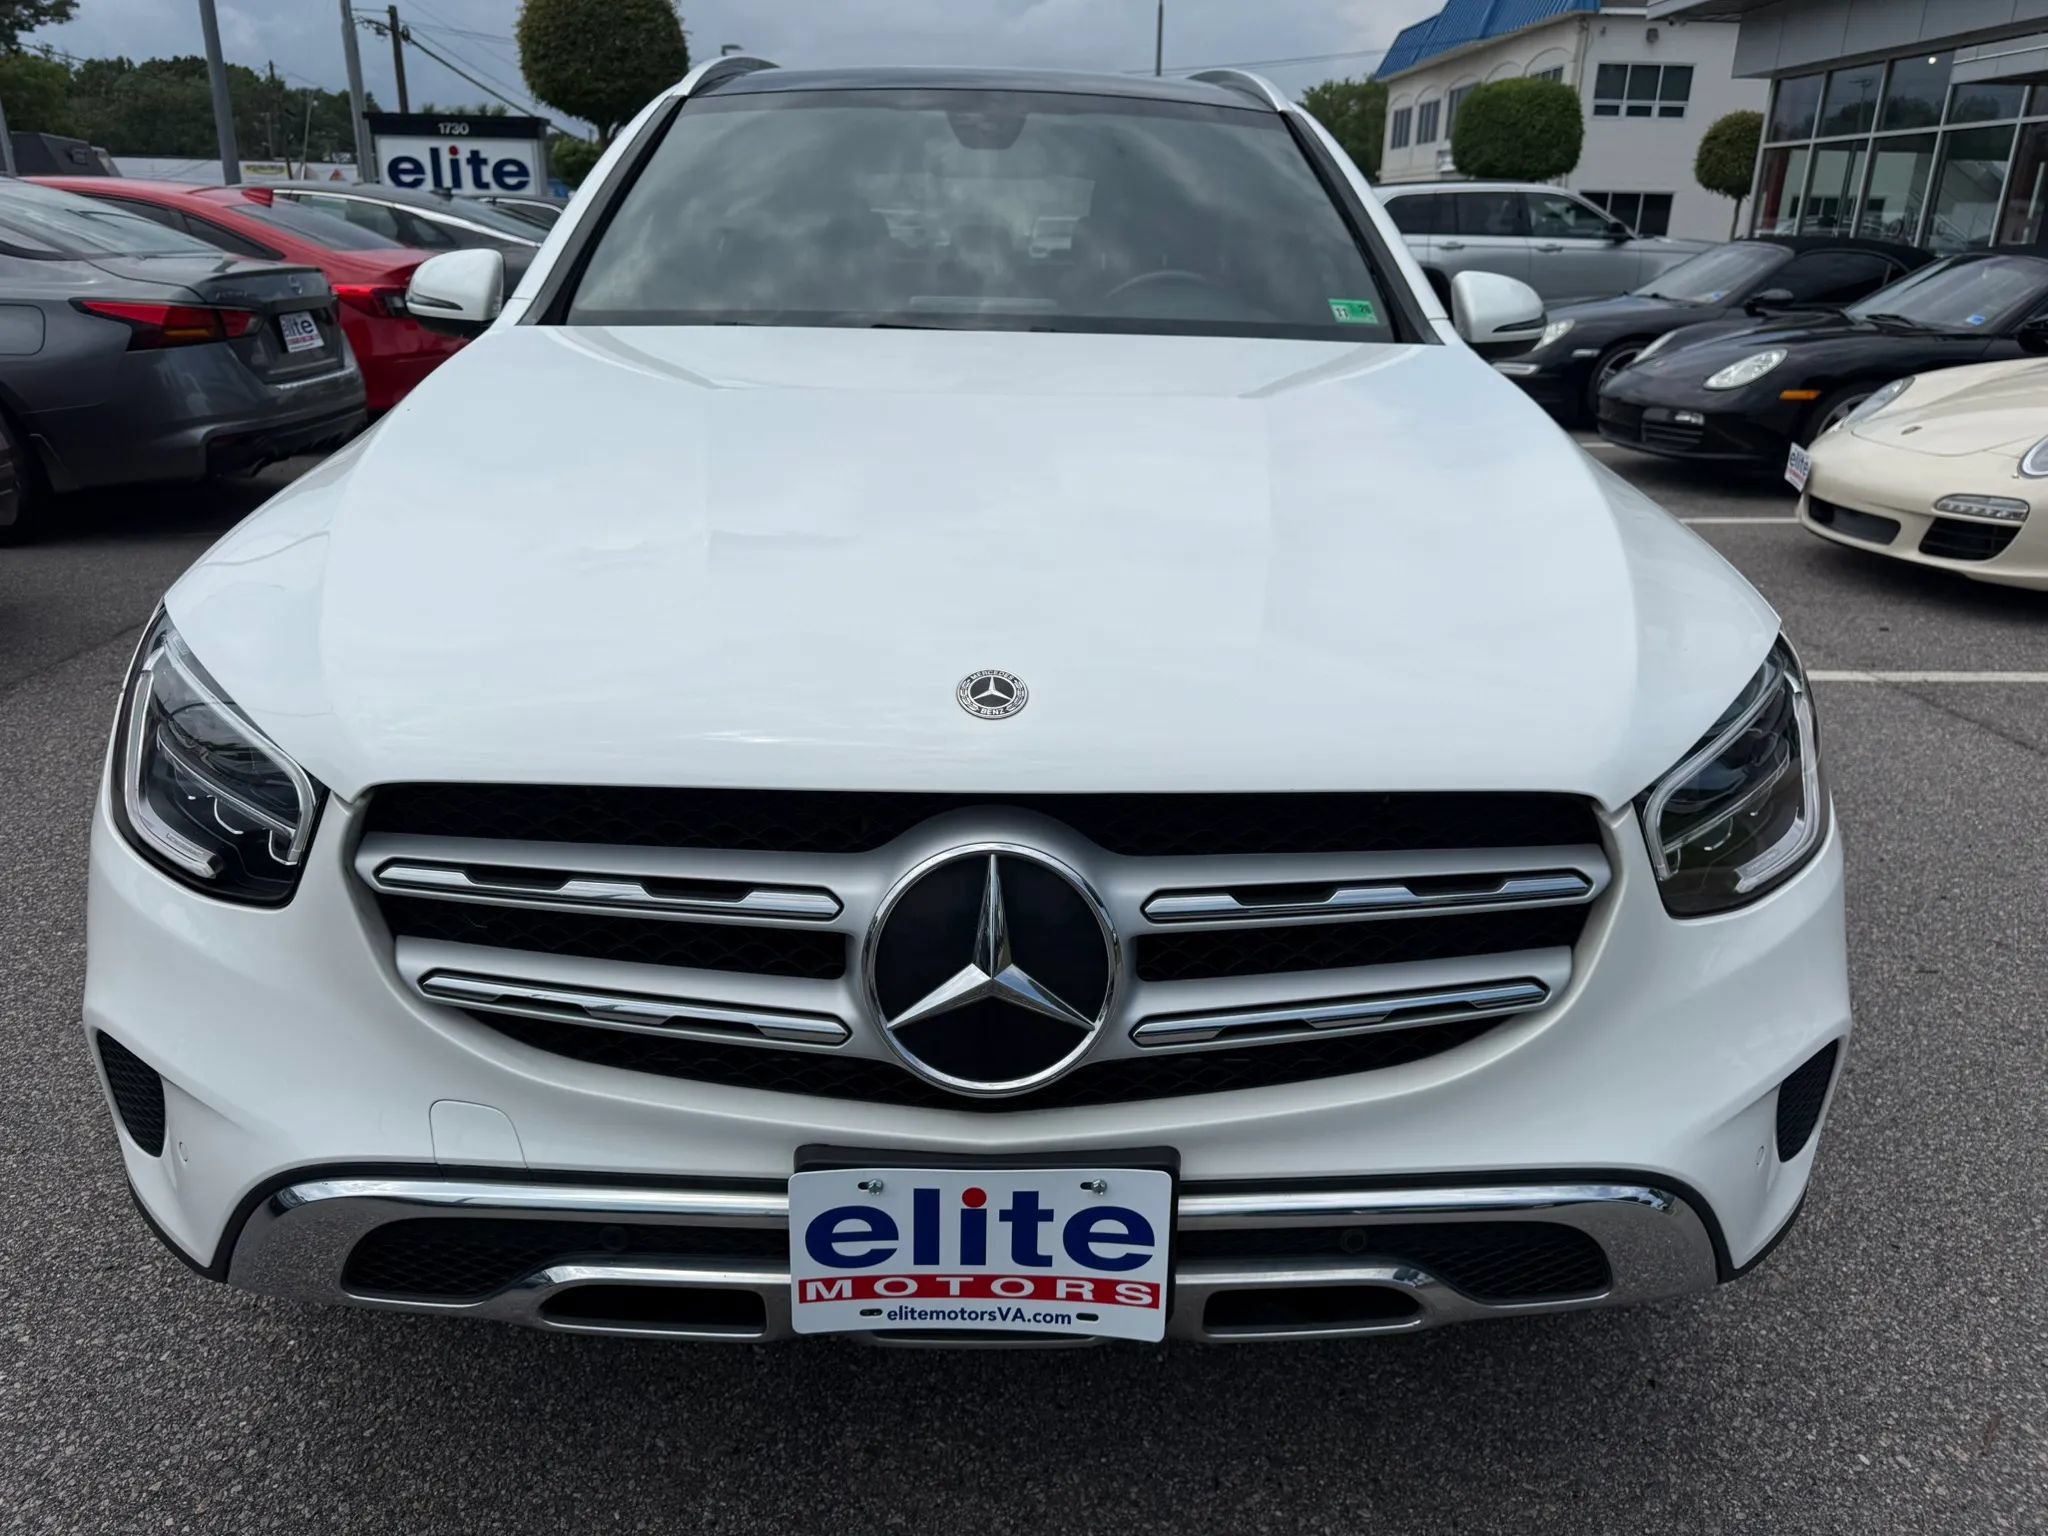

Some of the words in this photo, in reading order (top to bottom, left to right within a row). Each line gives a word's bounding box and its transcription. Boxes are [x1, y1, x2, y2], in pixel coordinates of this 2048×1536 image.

[438, 122, 470, 135] 1730
[387, 145, 531, 191] elite
[970, 669, 1015, 680] MERCEDES
[980, 706, 1006, 716] BENZ
[805, 1187, 1155, 1272] elite
[805, 1276, 1154, 1305] MOTORS
[887, 1304, 1072, 1325] elitemotorsVA.com
